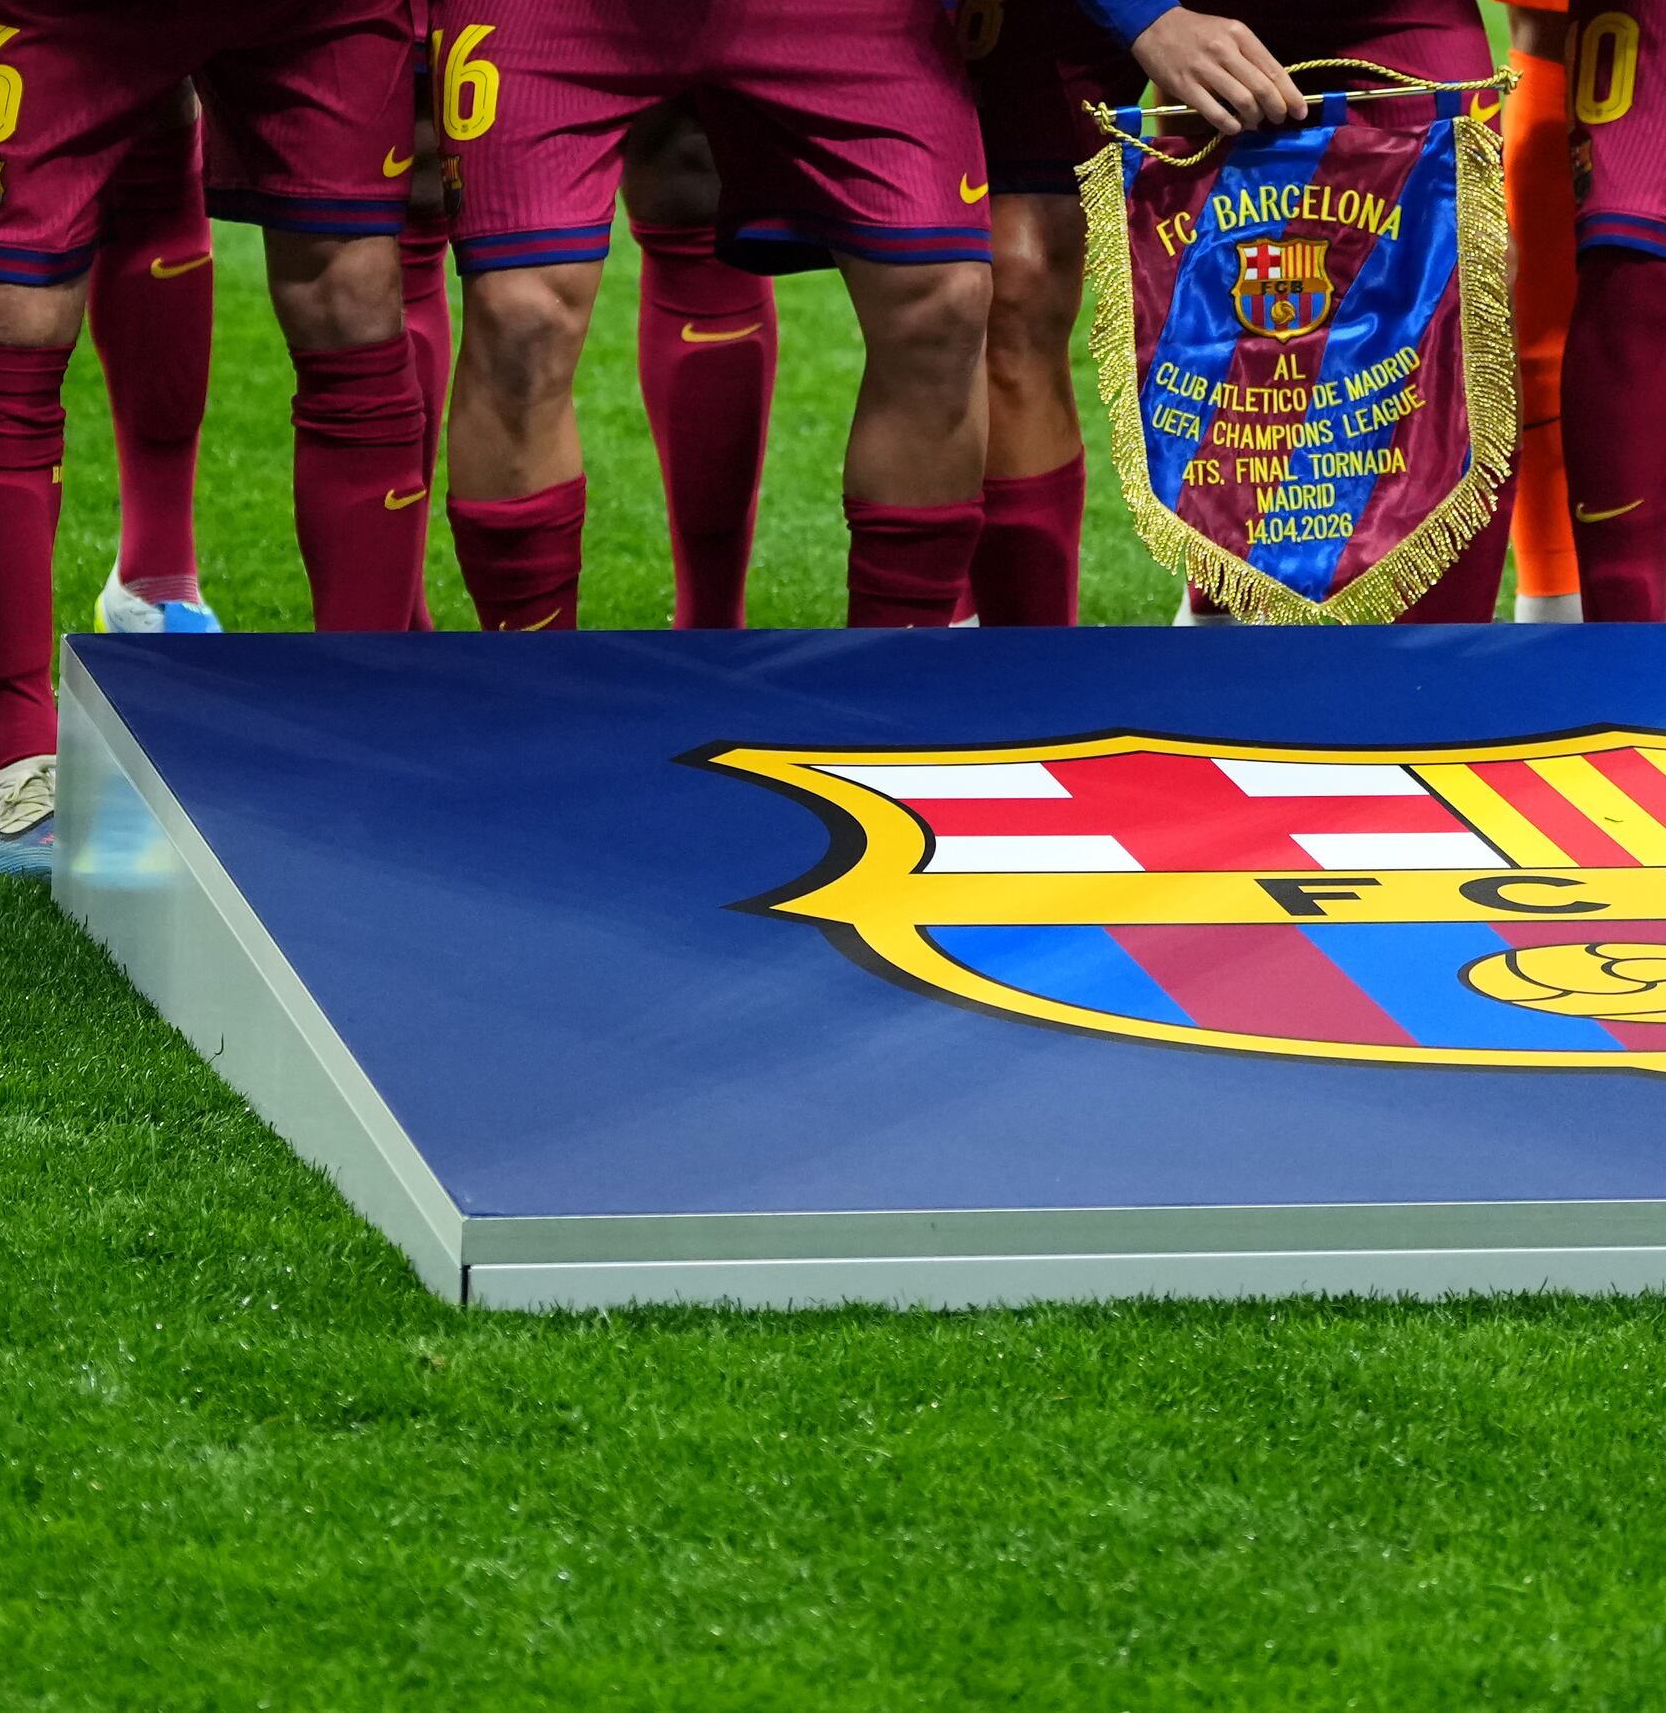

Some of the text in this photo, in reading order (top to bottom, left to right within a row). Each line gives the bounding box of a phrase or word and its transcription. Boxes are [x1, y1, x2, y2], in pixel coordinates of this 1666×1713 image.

[1155, 184, 1402, 257] FC BARCELONA
[1261, 280, 1303, 294] FCB
[1155, 345, 1422, 414] CLUB ATLETICO DE MADRID
[1273, 353, 1306, 381] AL
[1151, 384, 1426, 451] UEFA CHAMPIONS LEAGUE
[1182, 447, 1407, 486] 4TS. FINAL TORNADA
[1256, 482, 1335, 514] MADRID
[1245, 512, 1354, 545] 14.04.2026
